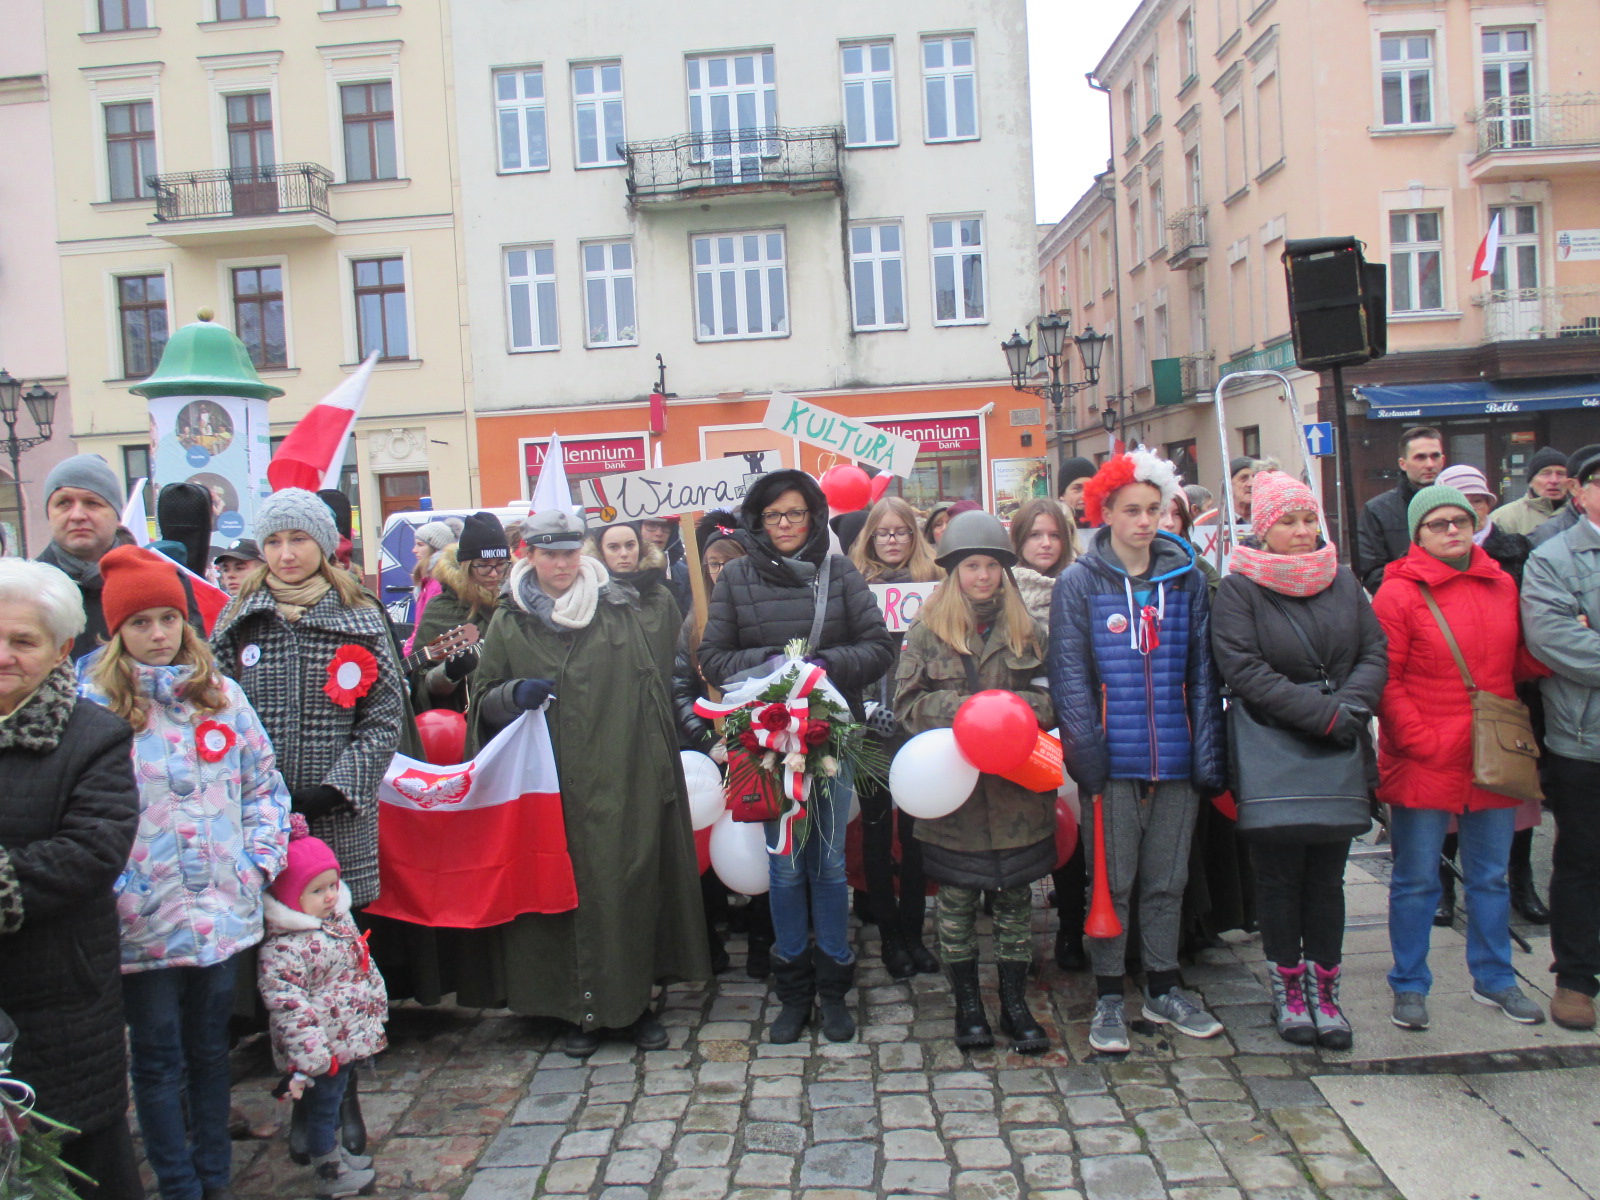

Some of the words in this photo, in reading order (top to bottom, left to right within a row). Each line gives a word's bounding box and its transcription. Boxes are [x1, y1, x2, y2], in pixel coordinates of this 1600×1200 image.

[1377, 409, 1421, 418] Restaurant
[1485, 402, 1520, 413] Belle
[781, 400, 895, 470] KULTURA
[880, 424, 970, 441] illennium
[938, 440, 961, 449] bank
[535, 445, 635, 464] Mlennium
[604, 460, 627, 470] bank
[616, 476, 734, 517] Wiara
[481, 548, 507, 559] UNICORN
